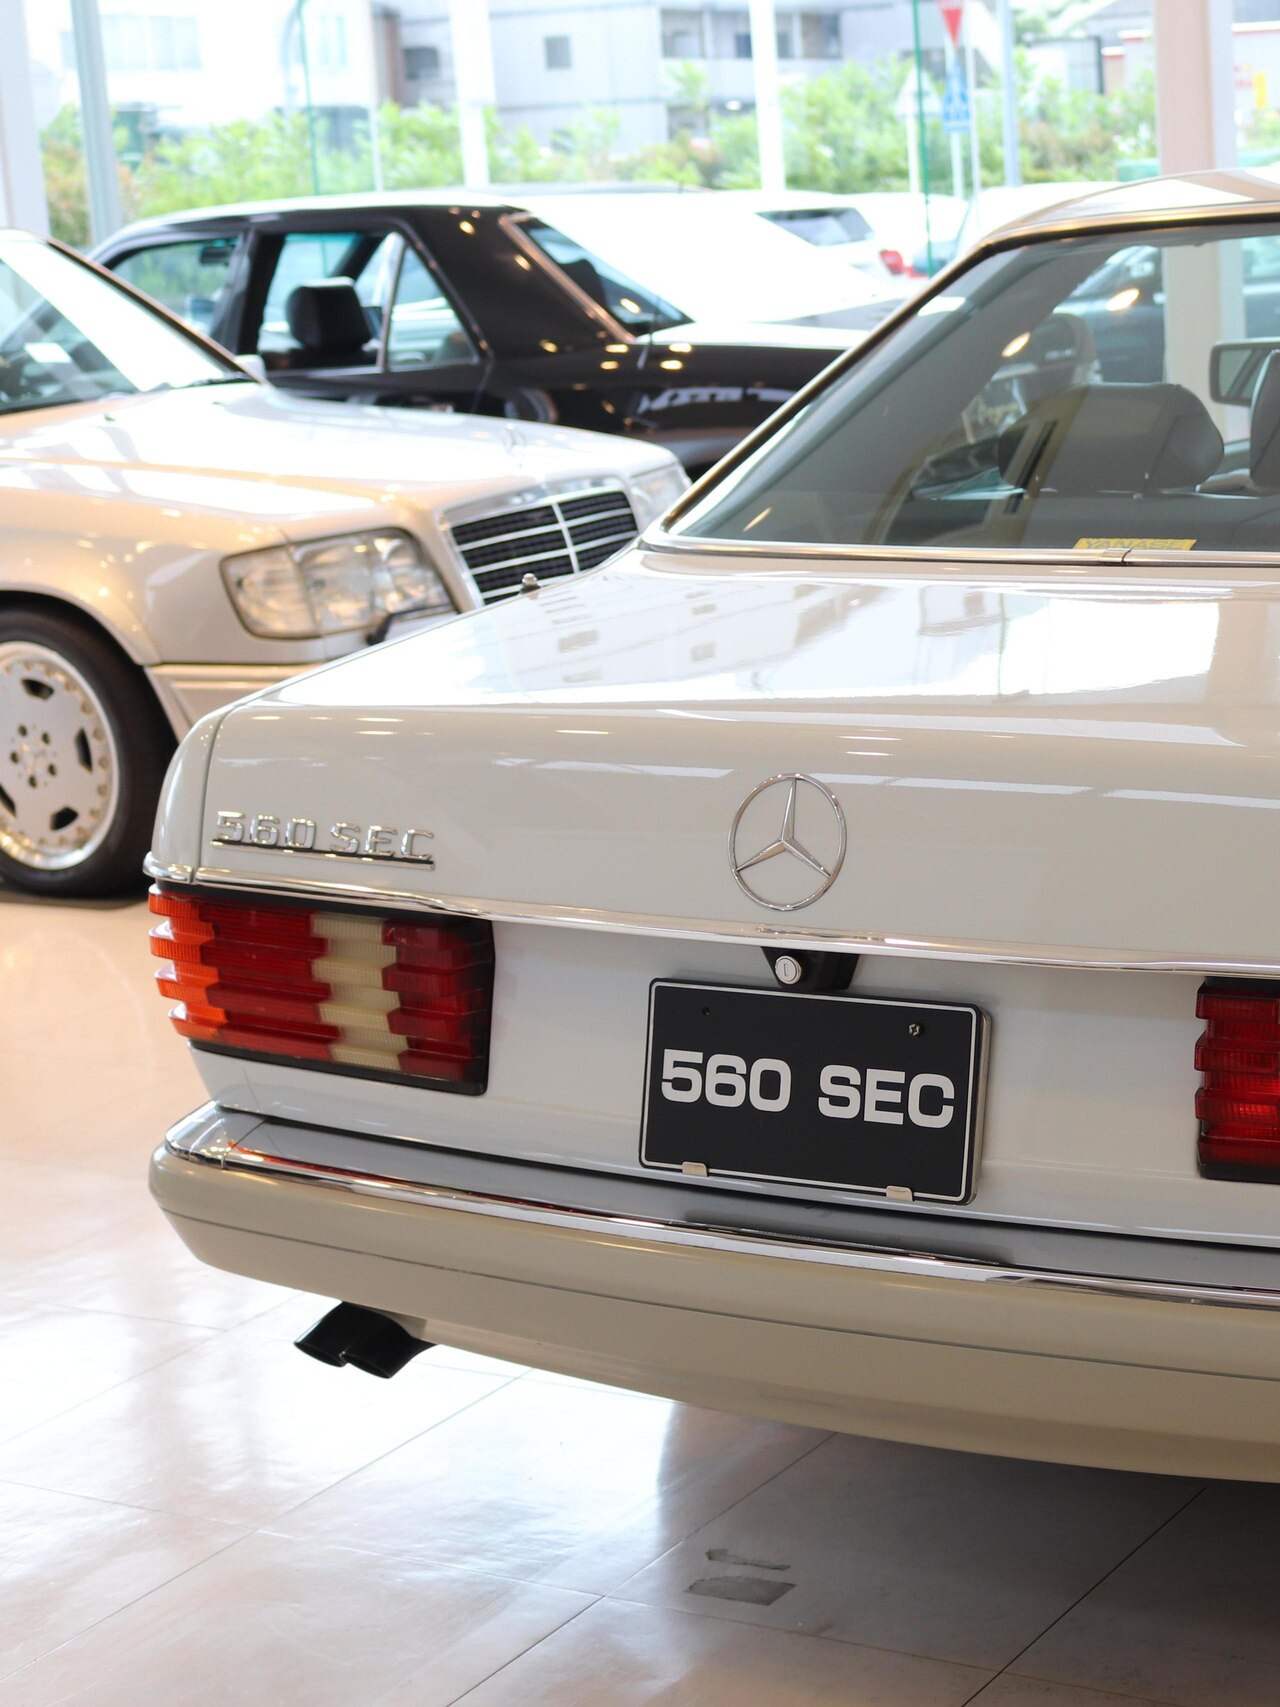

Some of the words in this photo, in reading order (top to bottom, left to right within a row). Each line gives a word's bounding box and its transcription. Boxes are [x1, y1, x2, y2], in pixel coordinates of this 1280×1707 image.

[216, 810, 317, 849] 560
[330, 822, 434, 861] SEC
[661, 1049, 792, 1112] 560
[818, 1064, 955, 1128] SEC
